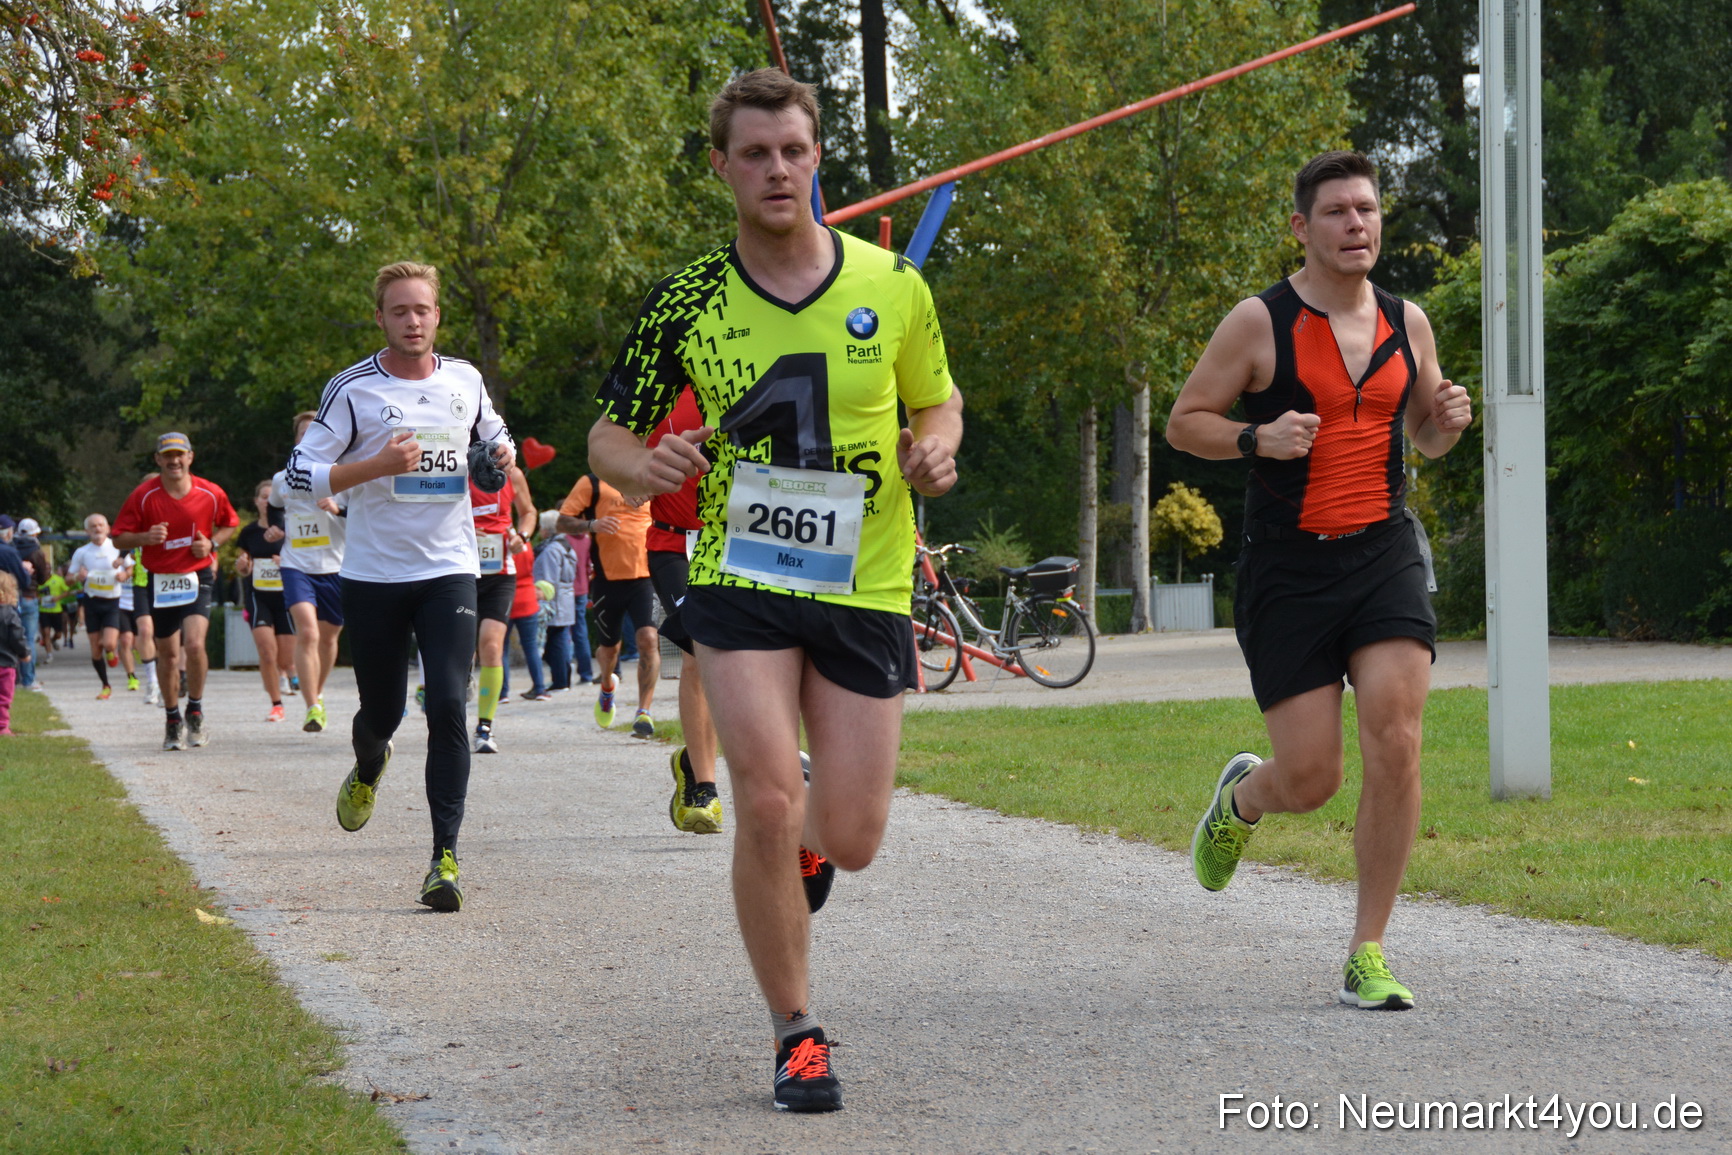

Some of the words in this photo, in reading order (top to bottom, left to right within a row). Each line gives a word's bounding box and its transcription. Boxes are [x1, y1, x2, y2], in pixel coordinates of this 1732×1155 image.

[846, 343, 882, 357] Partl
[848, 441, 868, 451] BMW
[412, 450, 458, 472] 545
[420, 480, 446, 489] Florian
[781, 479, 826, 493] BOCK
[298, 523, 319, 536] 174
[747, 503, 836, 546] 2661
[776, 552, 804, 568] Max
[161, 577, 191, 592] 2449
